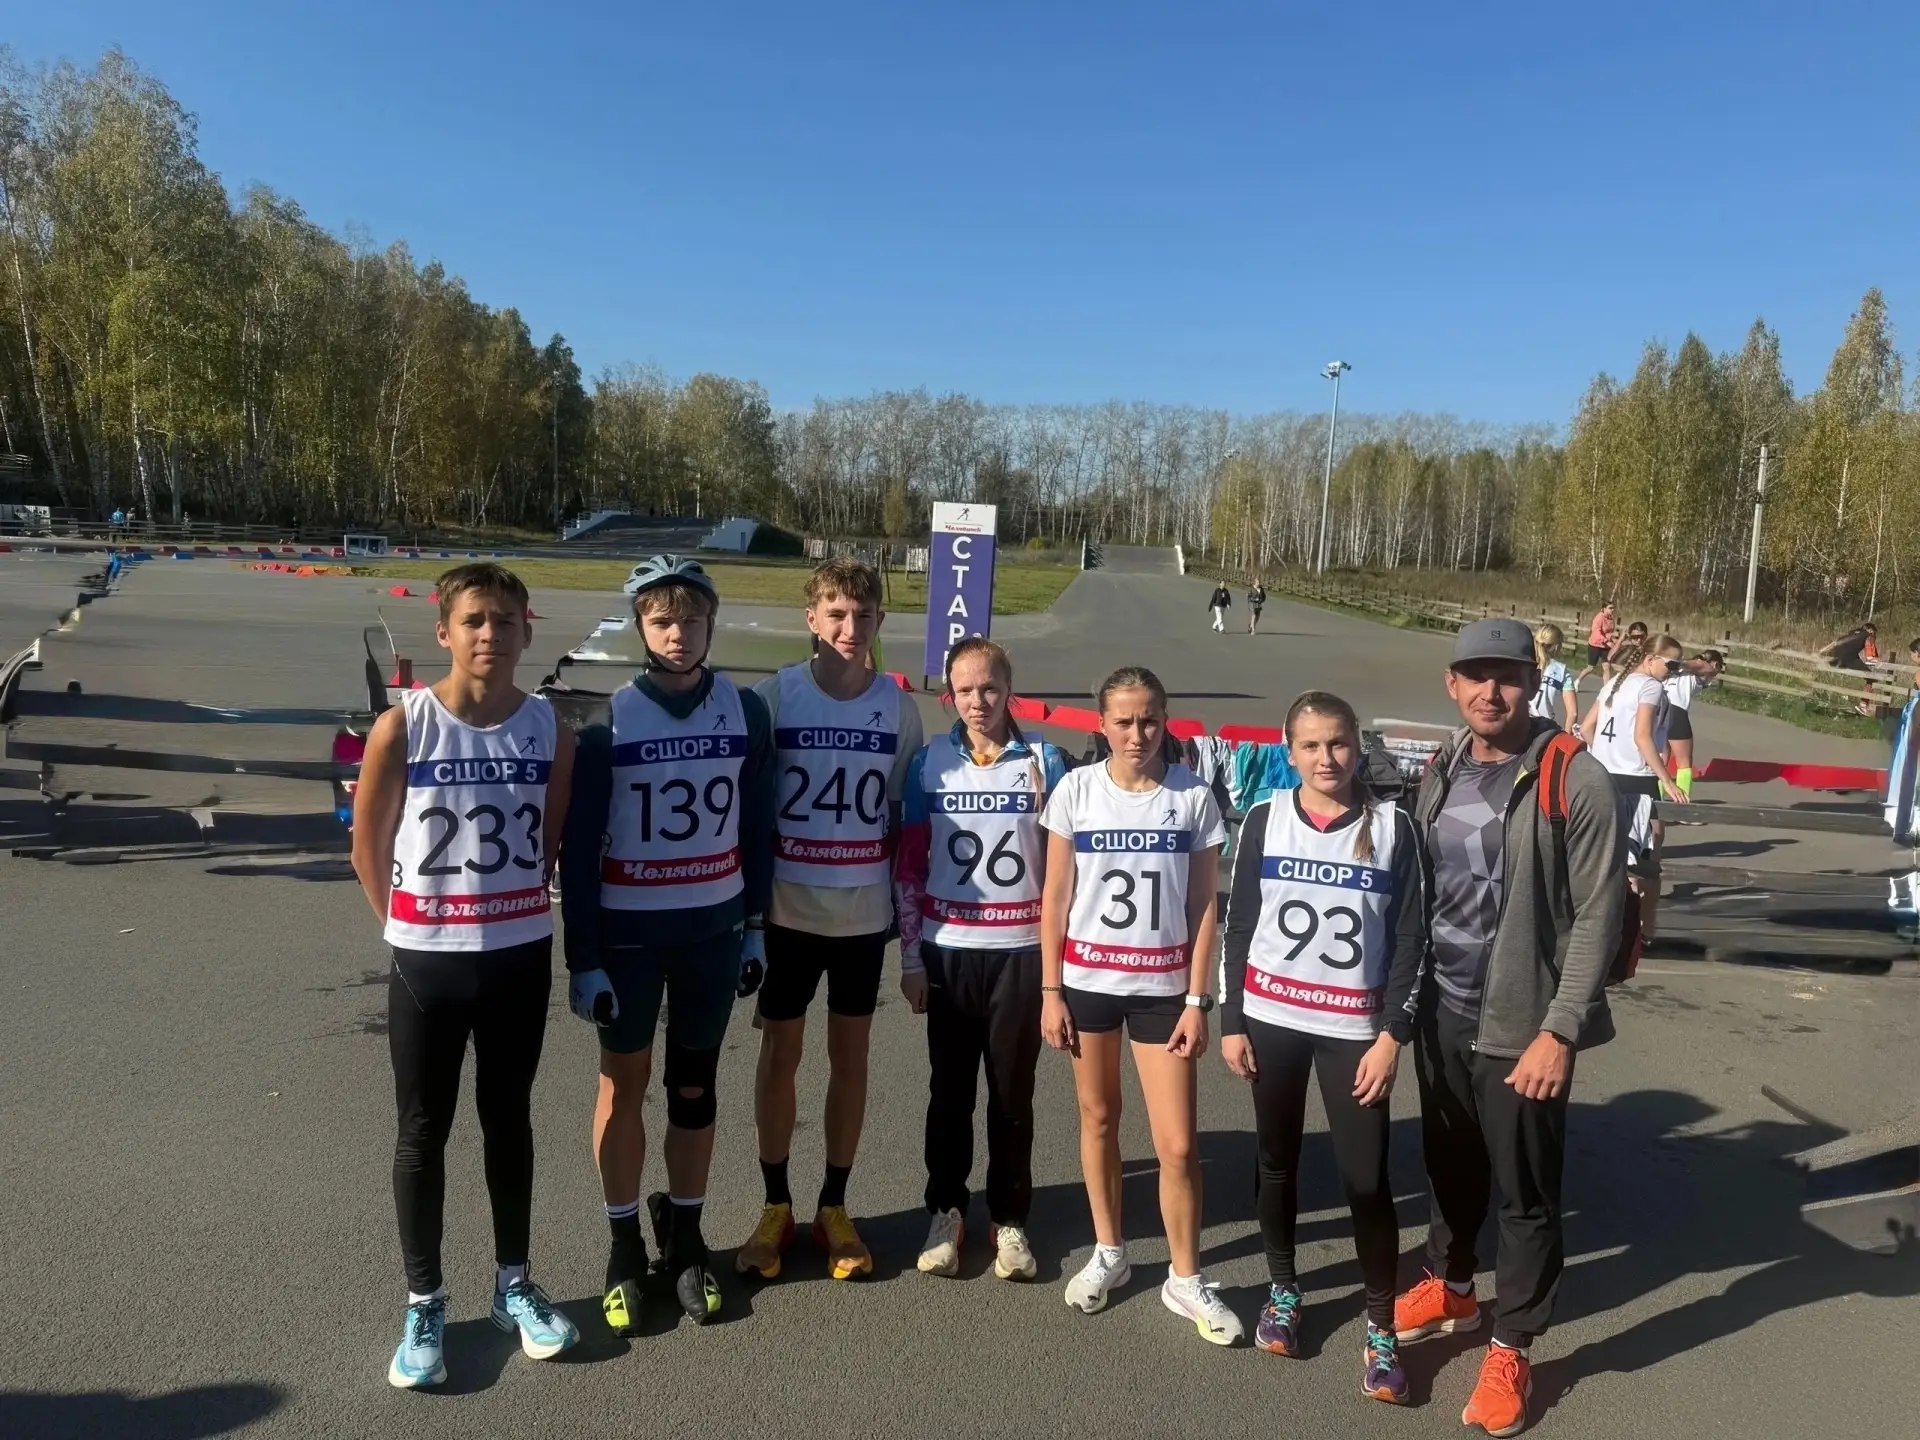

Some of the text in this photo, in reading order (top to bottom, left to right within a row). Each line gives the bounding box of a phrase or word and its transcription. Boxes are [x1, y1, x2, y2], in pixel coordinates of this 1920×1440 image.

[942, 536, 972, 684] СТАР
[798, 730, 880, 750] СШОР 5
[1601, 716, 1616, 742] 4
[640, 738, 730, 761] СШОР 5
[433, 761, 538, 783] СШОР 5
[630, 775, 734, 843] 139
[780, 765, 886, 825] 240
[943, 794, 1028, 811] СШОР 5
[417, 802, 542, 877] 233
[781, 837, 882, 860] Челябинск
[1091, 832, 1177, 851] СШОР 5
[623, 852, 736, 880] Челябинск
[947, 829, 1026, 888] 96
[1277, 859, 1373, 888] СШОР 5
[415, 889, 549, 918] Челябинск
[933, 899, 1041, 921] Челябинск
[1100, 868, 1161, 931] 31
[1277, 899, 1363, 970] 93
[1074, 942, 1184, 967] Челябинск
[1254, 970, 1377, 1009] Челябинск
